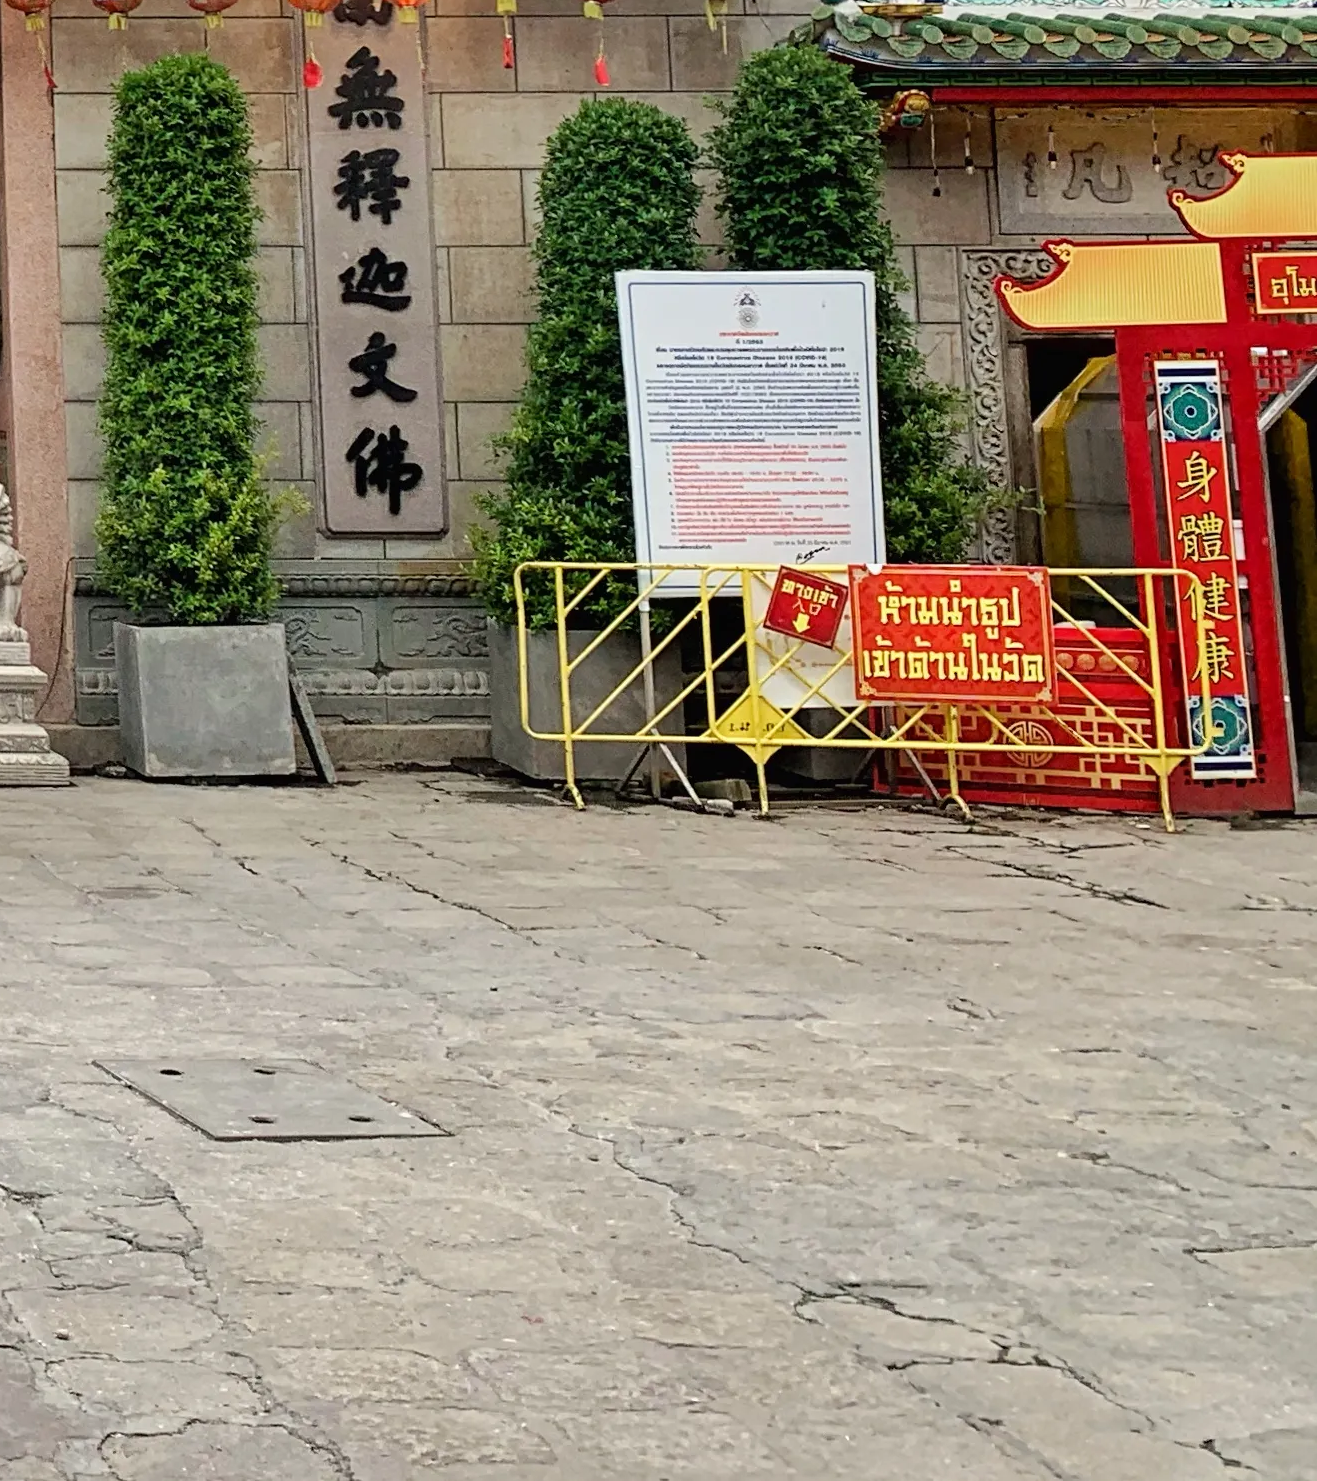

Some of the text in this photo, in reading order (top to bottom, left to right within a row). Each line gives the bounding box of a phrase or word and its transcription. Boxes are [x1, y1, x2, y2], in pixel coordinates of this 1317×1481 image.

[781, 578, 839, 609] ทางเข้า
[1176, 450, 1235, 684] 身體健康
[877, 580, 1022, 640] ห้ามนำธูป
[863, 633, 1046, 683] เข้าด้านในวัด
